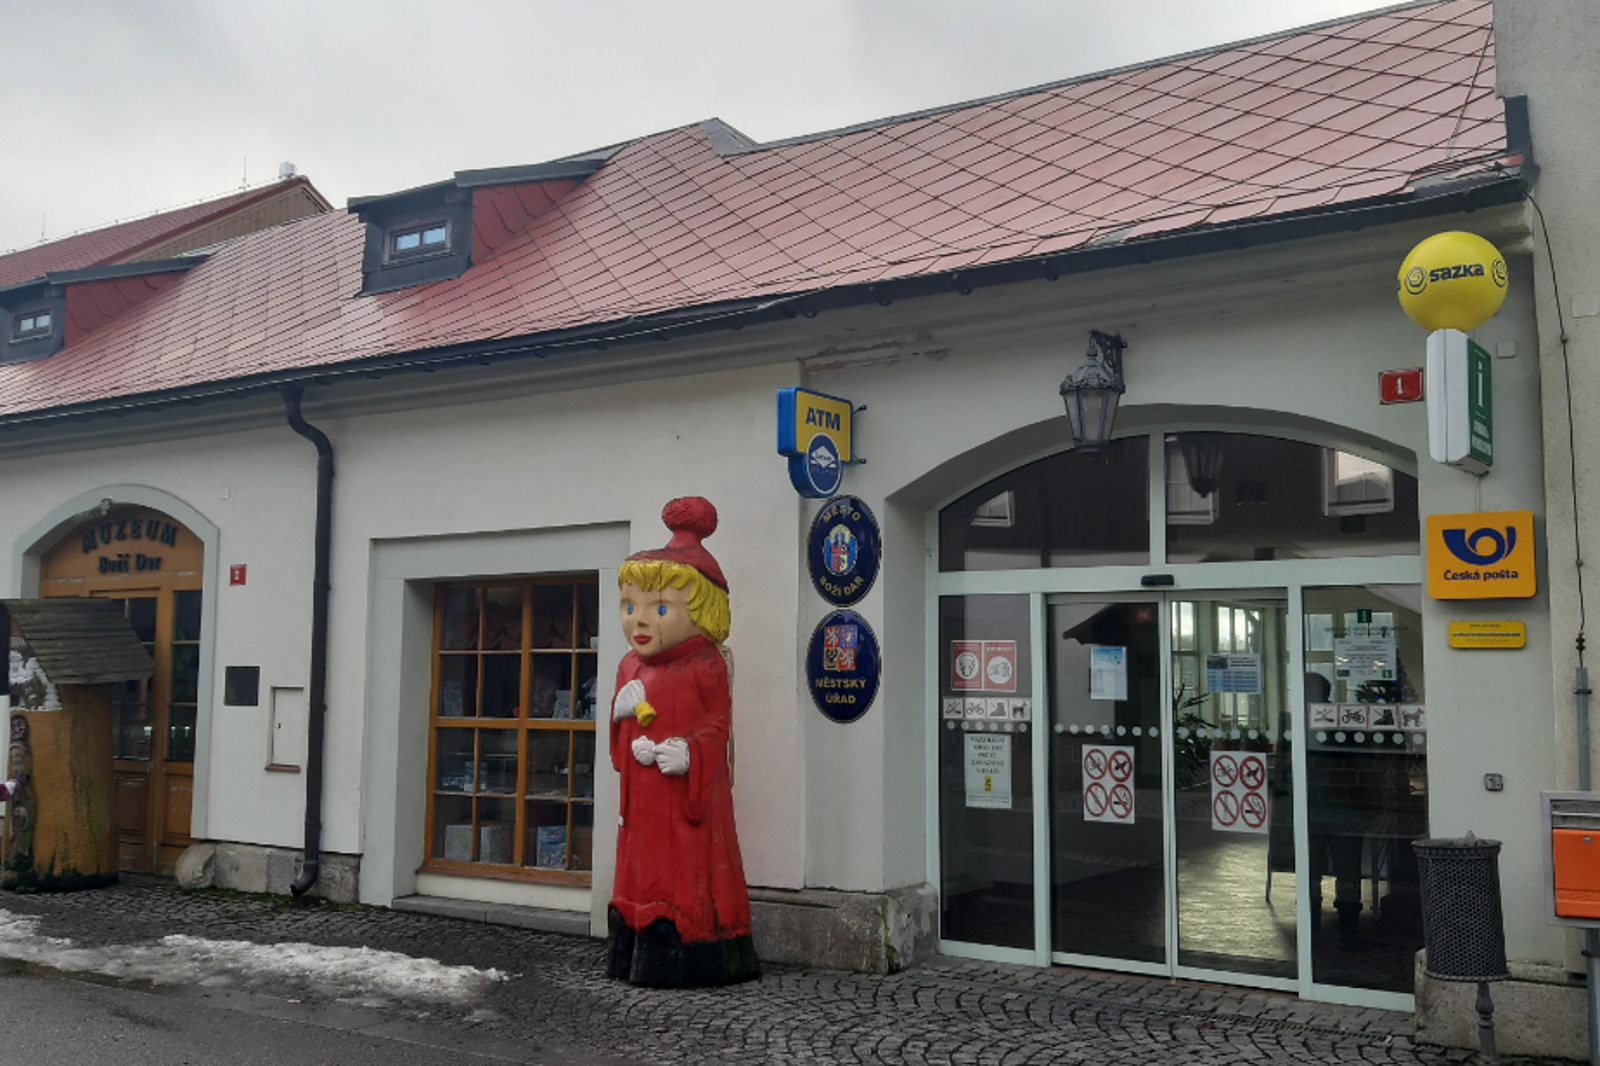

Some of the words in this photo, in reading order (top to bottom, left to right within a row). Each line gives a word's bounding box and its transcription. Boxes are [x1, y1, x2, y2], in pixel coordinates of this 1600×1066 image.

[1429, 263, 1485, 283] sazka
[1396, 377, 1404, 395] 1
[805, 406, 841, 431] ATM
[822, 504, 861, 523] MĚSTO
[82, 518, 178, 554] MUZEUM
[135, 553, 162, 570] Dar
[1443, 569, 1481, 581] Česká
[1483, 569, 1519, 582] pošta
[843, 576, 865, 597] DAR
[815, 675, 867, 689] MĚSTSKÝ
[825, 690, 857, 704] ÚŘAD
